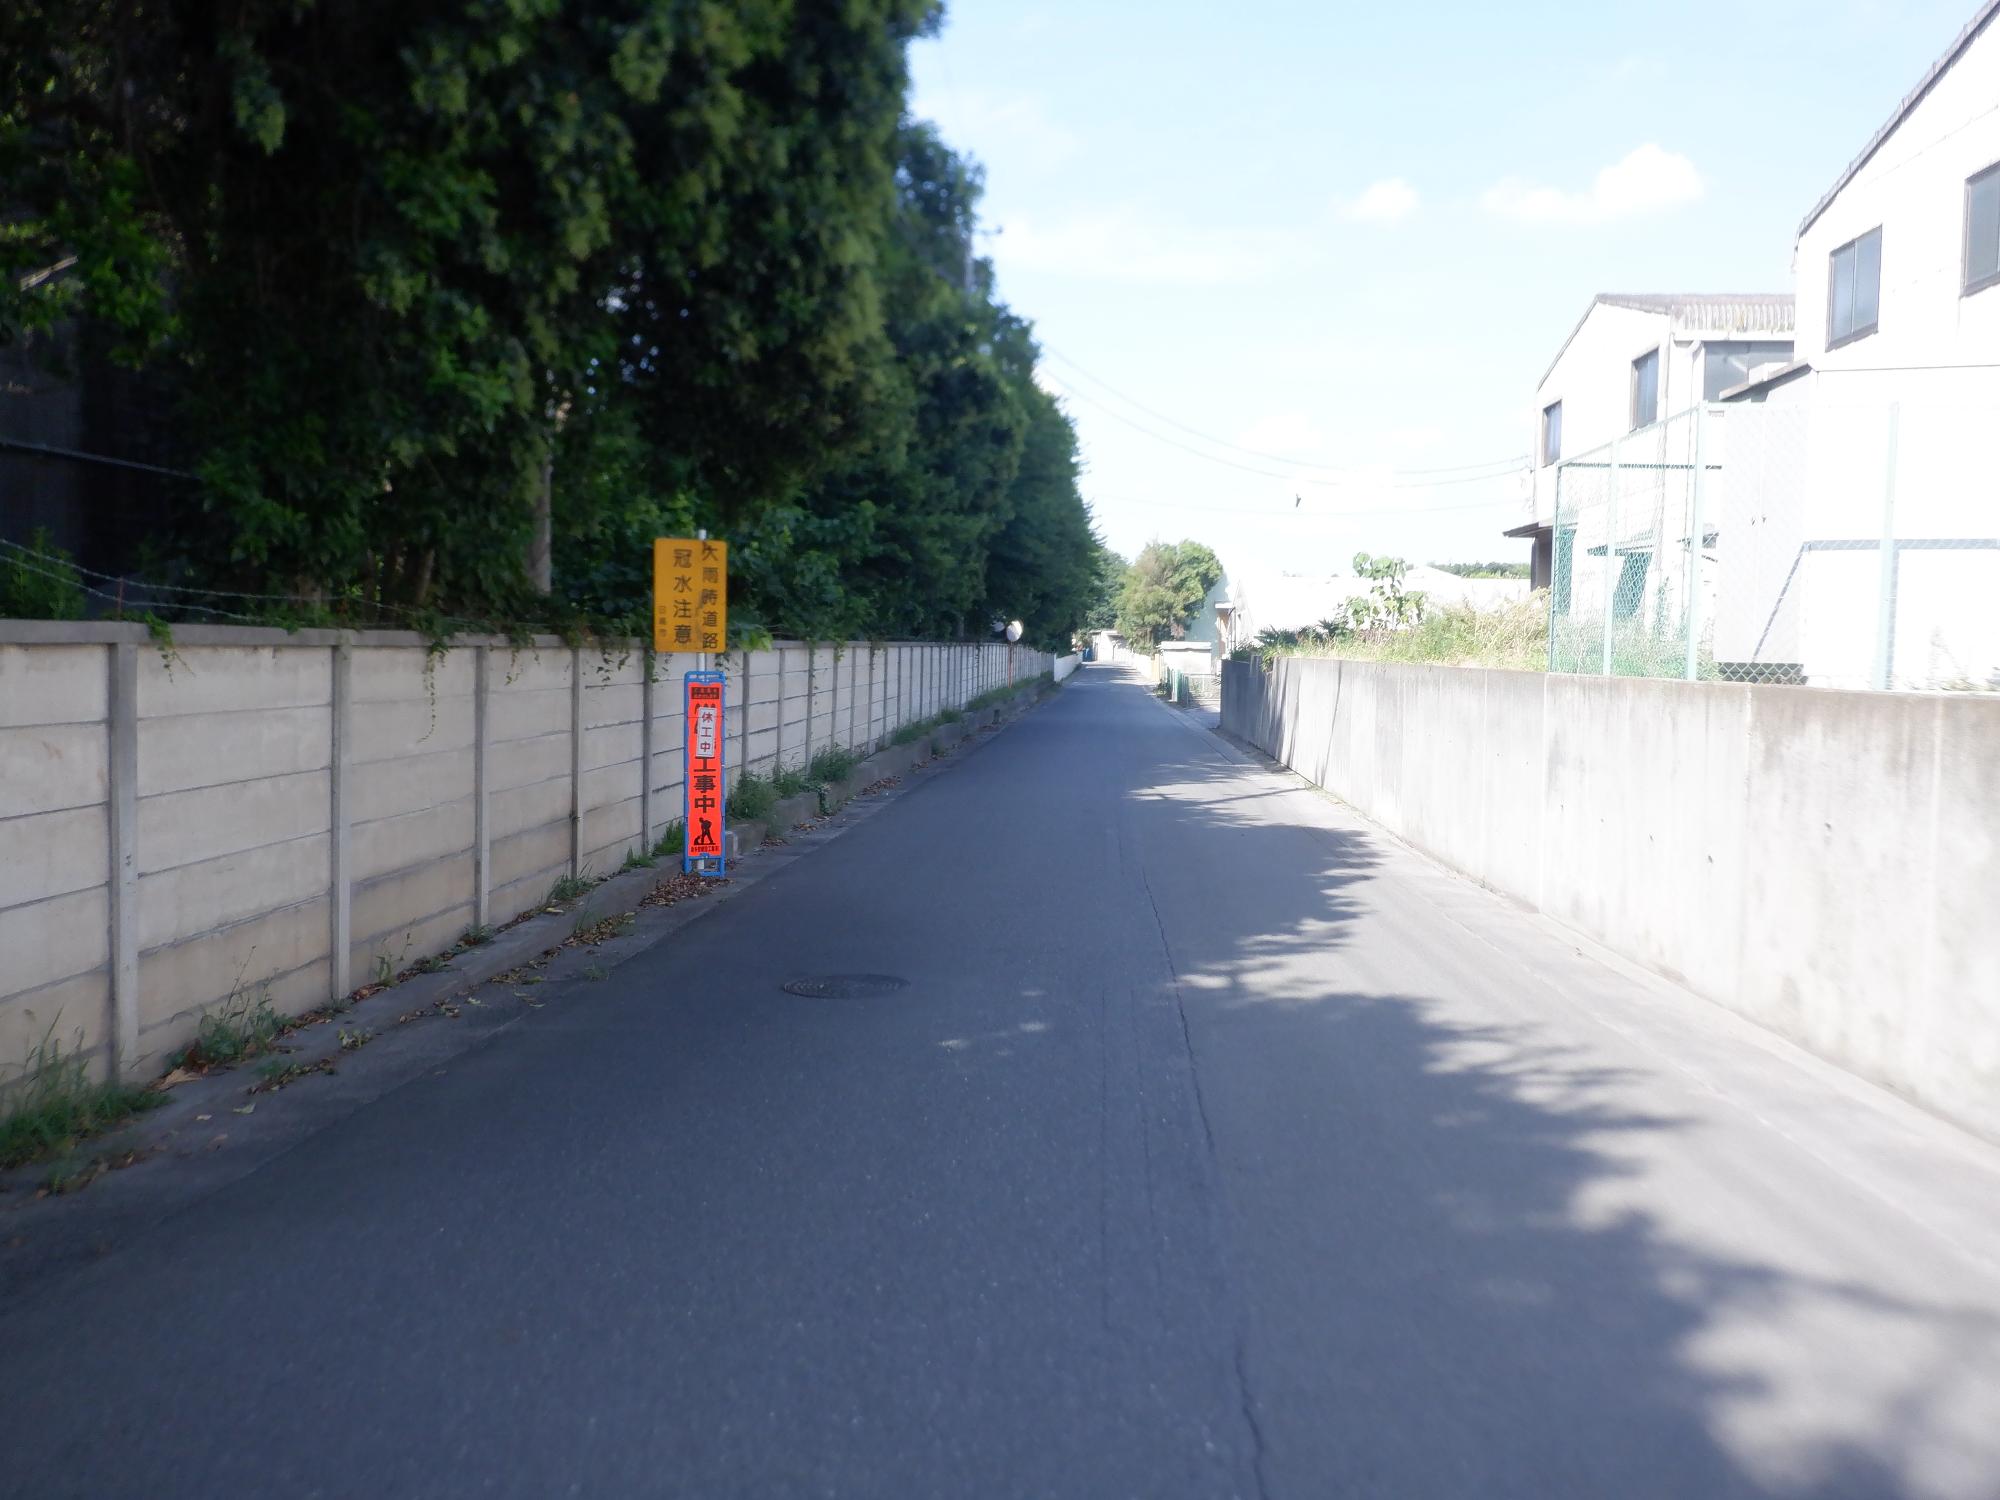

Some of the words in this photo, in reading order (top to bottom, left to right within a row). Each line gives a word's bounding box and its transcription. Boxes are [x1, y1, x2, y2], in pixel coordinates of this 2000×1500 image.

[673, 549, 692, 644] 冠水注意
[701, 711, 713, 752] 休工中
[693, 756, 717, 813] 工事中
